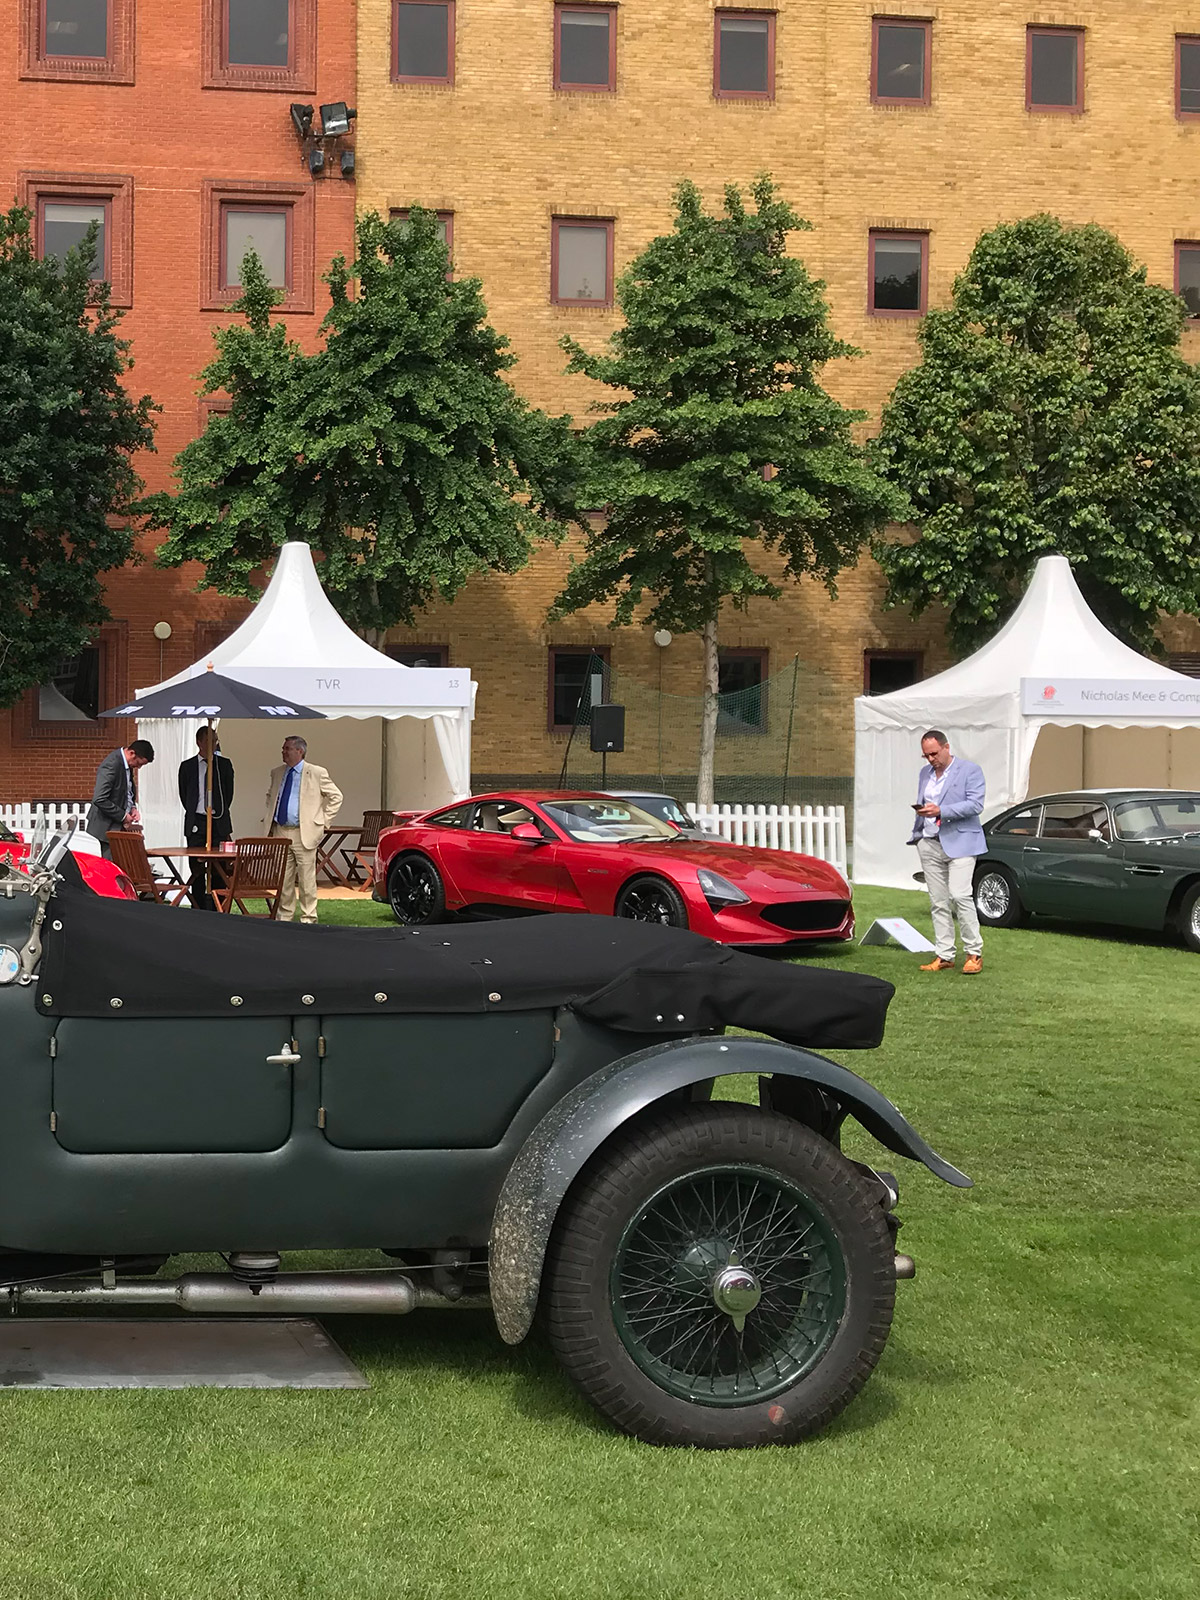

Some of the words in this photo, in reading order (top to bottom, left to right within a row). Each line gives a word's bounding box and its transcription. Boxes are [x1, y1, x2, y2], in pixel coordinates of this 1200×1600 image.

[315, 678, 341, 690] TVR
[448, 679, 460, 689] 13
[1080, 690, 1130, 701] Nicholas
[1131, 690, 1157, 702] Mee
[1158, 690, 1167, 702] &
[170, 705, 222, 715] TVR
